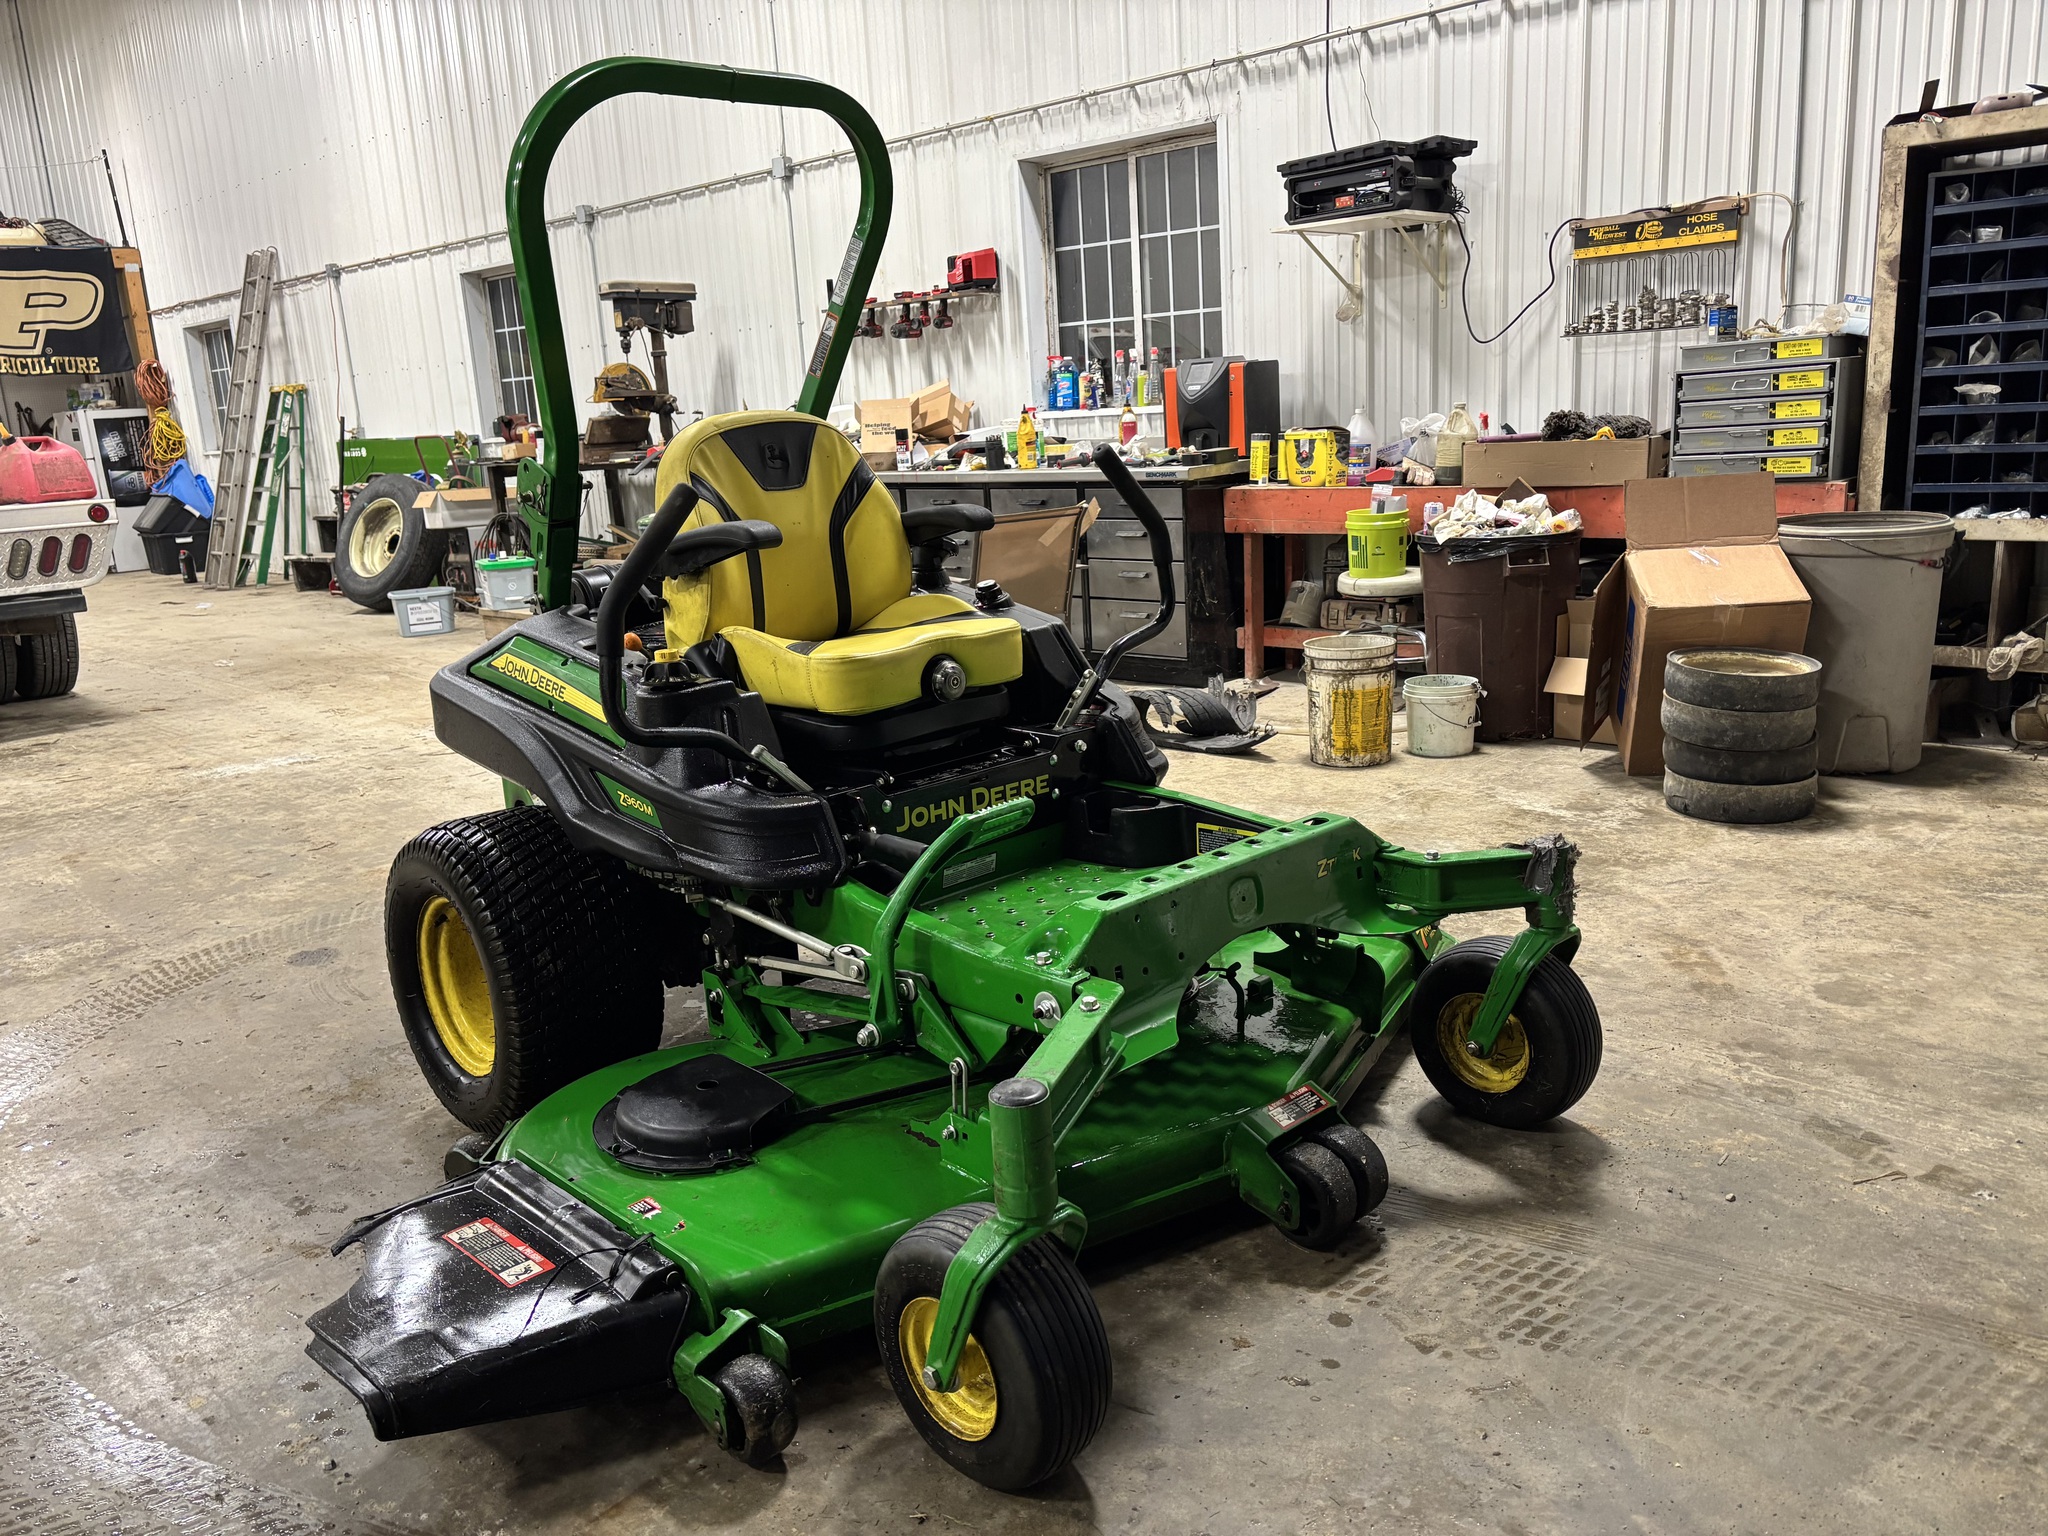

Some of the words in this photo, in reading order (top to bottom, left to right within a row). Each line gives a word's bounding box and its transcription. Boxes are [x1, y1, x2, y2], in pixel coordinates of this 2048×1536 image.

[1686, 212, 1718, 224] HOSE
[1588, 225, 1620, 237] KIMBALL
[1594, 231, 1628, 241] MIDWEST
[1678, 222, 1725, 236] CLAMPS
[108, 430, 128, 459] BUSTED
[1145, 471, 1178, 479] BENCHMARK
[500, 656, 530, 684] JOHN
[530, 668, 567, 700] DEERE
[616, 790, 654, 817] Z960M
[896, 795, 965, 833] JOHN
[971, 774, 1050, 811] DEERE
